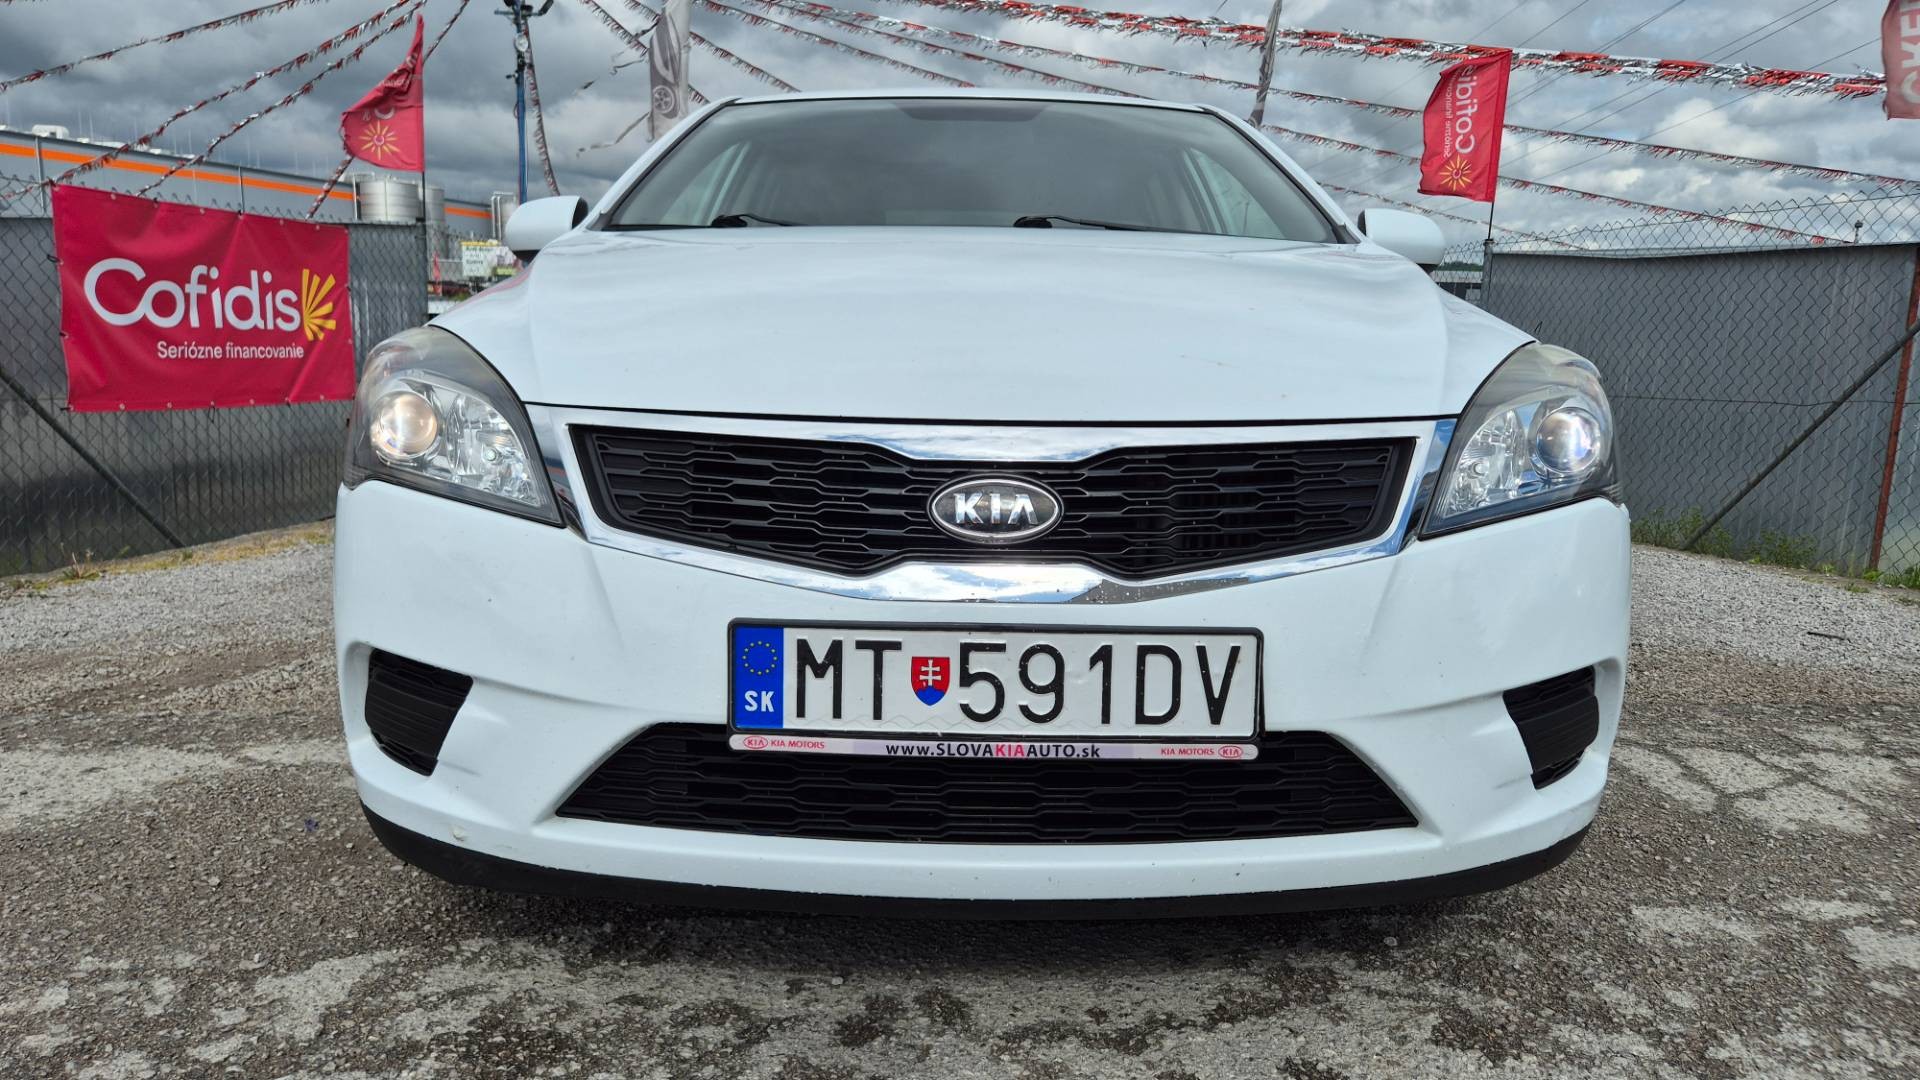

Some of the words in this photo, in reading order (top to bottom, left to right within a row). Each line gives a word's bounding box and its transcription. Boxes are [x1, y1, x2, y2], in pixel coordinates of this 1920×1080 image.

[83, 257, 301, 332] Cofidis
[157, 340, 223, 359] Seriózne
[225, 341, 304, 359] financovanie
[953, 492, 1039, 525] KIA
[744, 690, 775, 712] SK
[770, 740, 785, 748] KIA
[788, 740, 825, 749] MOTORS
[885, 743, 1100, 758] www.SLOVAKIAAUTO.sk
[1161, 748, 1175, 756] KIA
[1178, 748, 1214, 756] MOTORS
